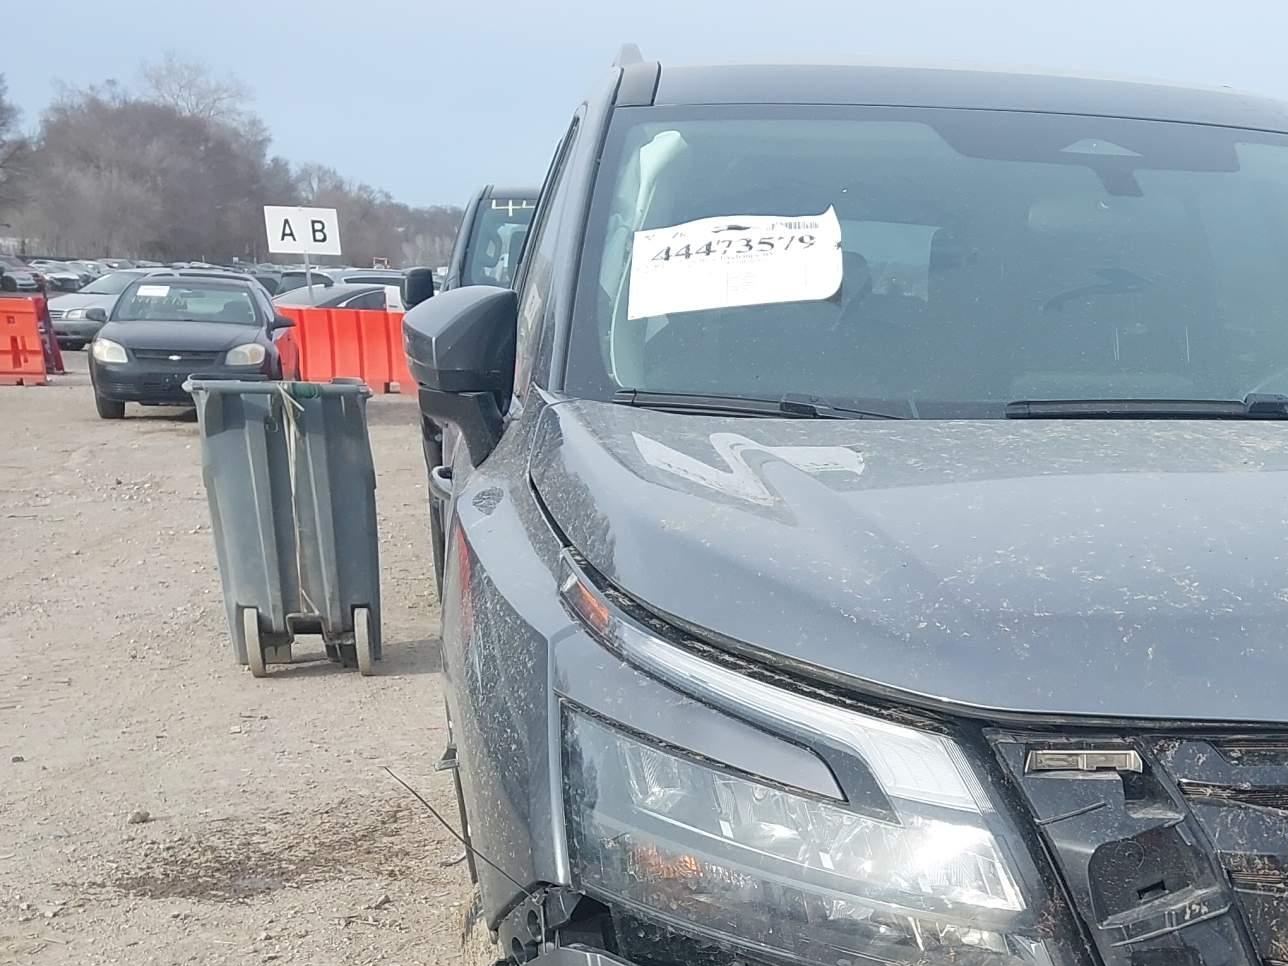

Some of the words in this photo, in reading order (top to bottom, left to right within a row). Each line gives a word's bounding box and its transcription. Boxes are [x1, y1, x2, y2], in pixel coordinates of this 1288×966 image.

[280, 218, 297, 242] A
[311, 219, 327, 243] B
[651, 234, 816, 262] 44473579
